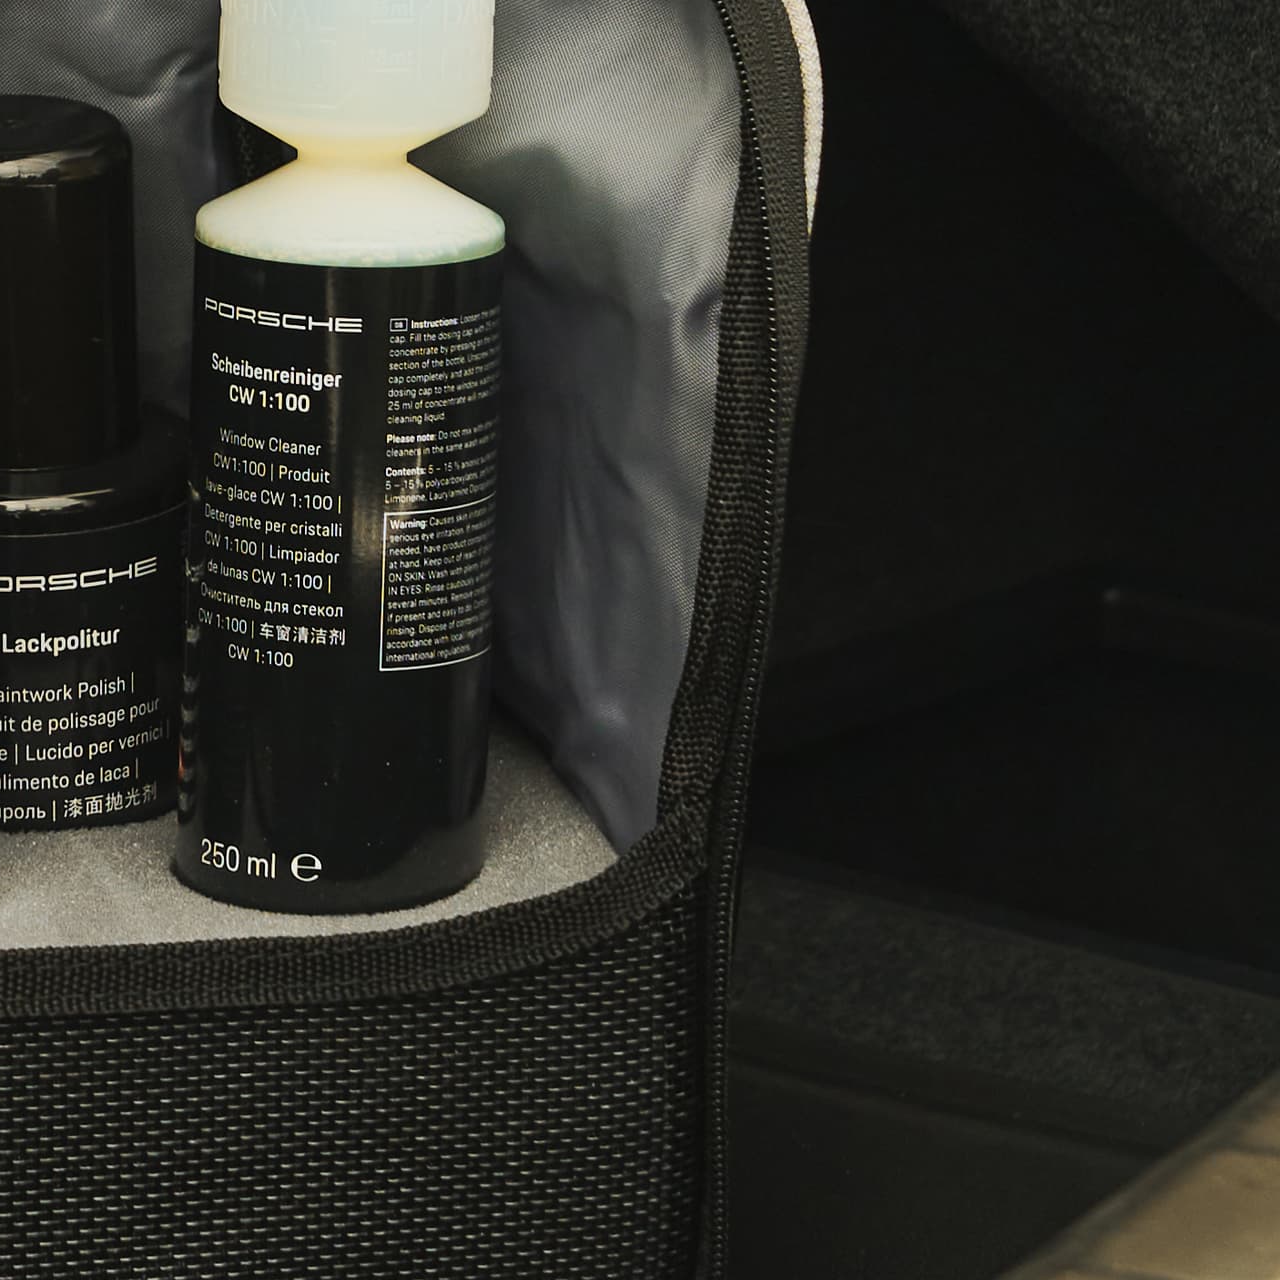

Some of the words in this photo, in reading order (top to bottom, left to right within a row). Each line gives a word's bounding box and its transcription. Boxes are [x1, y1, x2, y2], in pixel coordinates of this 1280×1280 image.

[204, 297, 363, 333] PORSCHE
[424, 332, 437, 341] the
[389, 347, 439, 358] concentrate
[211, 352, 342, 391] Scheibenreiniger
[388, 360, 420, 371] section
[421, 358, 430, 369] of
[432, 358, 444, 368] the
[388, 374, 404, 385] cap
[229, 384, 254, 405] CW
[259, 390, 310, 413] 1:100
[388, 386, 417, 399] dosing
[418, 387, 433, 398] cap
[434, 385, 442, 395] to
[387, 400, 400, 411] 25
[414, 399, 423, 410] of
[387, 414, 422, 425] cleaning
[220, 427, 265, 451] Window
[269, 437, 321, 456] Cleaner
[386, 433, 416, 444] Please
[279, 465, 330, 483] Produit
[206, 476, 257, 502] lave-glace
[260, 489, 285, 506] CW
[290, 494, 333, 511] 1:100
[205, 503, 261, 530] Detergente
[265, 517, 286, 535] per
[290, 522, 342, 538] cristalli
[205, 530, 221, 548] CW
[224, 535, 257, 556] 1:100
[269, 547, 340, 565] Limpiador
[208, 559, 218, 574] de
[220, 560, 249, 582] lunas
[252, 568, 276, 585] CW
[280, 573, 323, 590] 1:100
[388, 572, 402, 583] ON
[388, 585, 398, 596] IN
[264, 599, 290, 615] для
[293, 602, 344, 618] стекол
[387, 598, 417, 610] several
[198, 607, 213, 625] CW
[216, 613, 248, 634] 1:100
[259, 622, 346, 646] 车窗清洁剂
[395, 611, 426, 624] present
[2, 628, 120, 657] Lackpolitur
[386, 637, 433, 650] accordance
[228, 643, 250, 662] CW
[253, 647, 294, 668] 1:100
[385, 649, 436, 663] international
[78, 676, 126, 699] Polish
[21, 715, 42, 733] de
[48, 707, 125, 735] polissage
[129, 697, 160, 723] pour
[25, 741, 84, 762] Lucido
[89, 738, 114, 760] per
[119, 723, 163, 751] vernici
[75, 769, 95, 787] de
[100, 764, 130, 783] laca
[201, 837, 240, 872] 250
[247, 853, 276, 879] ml
